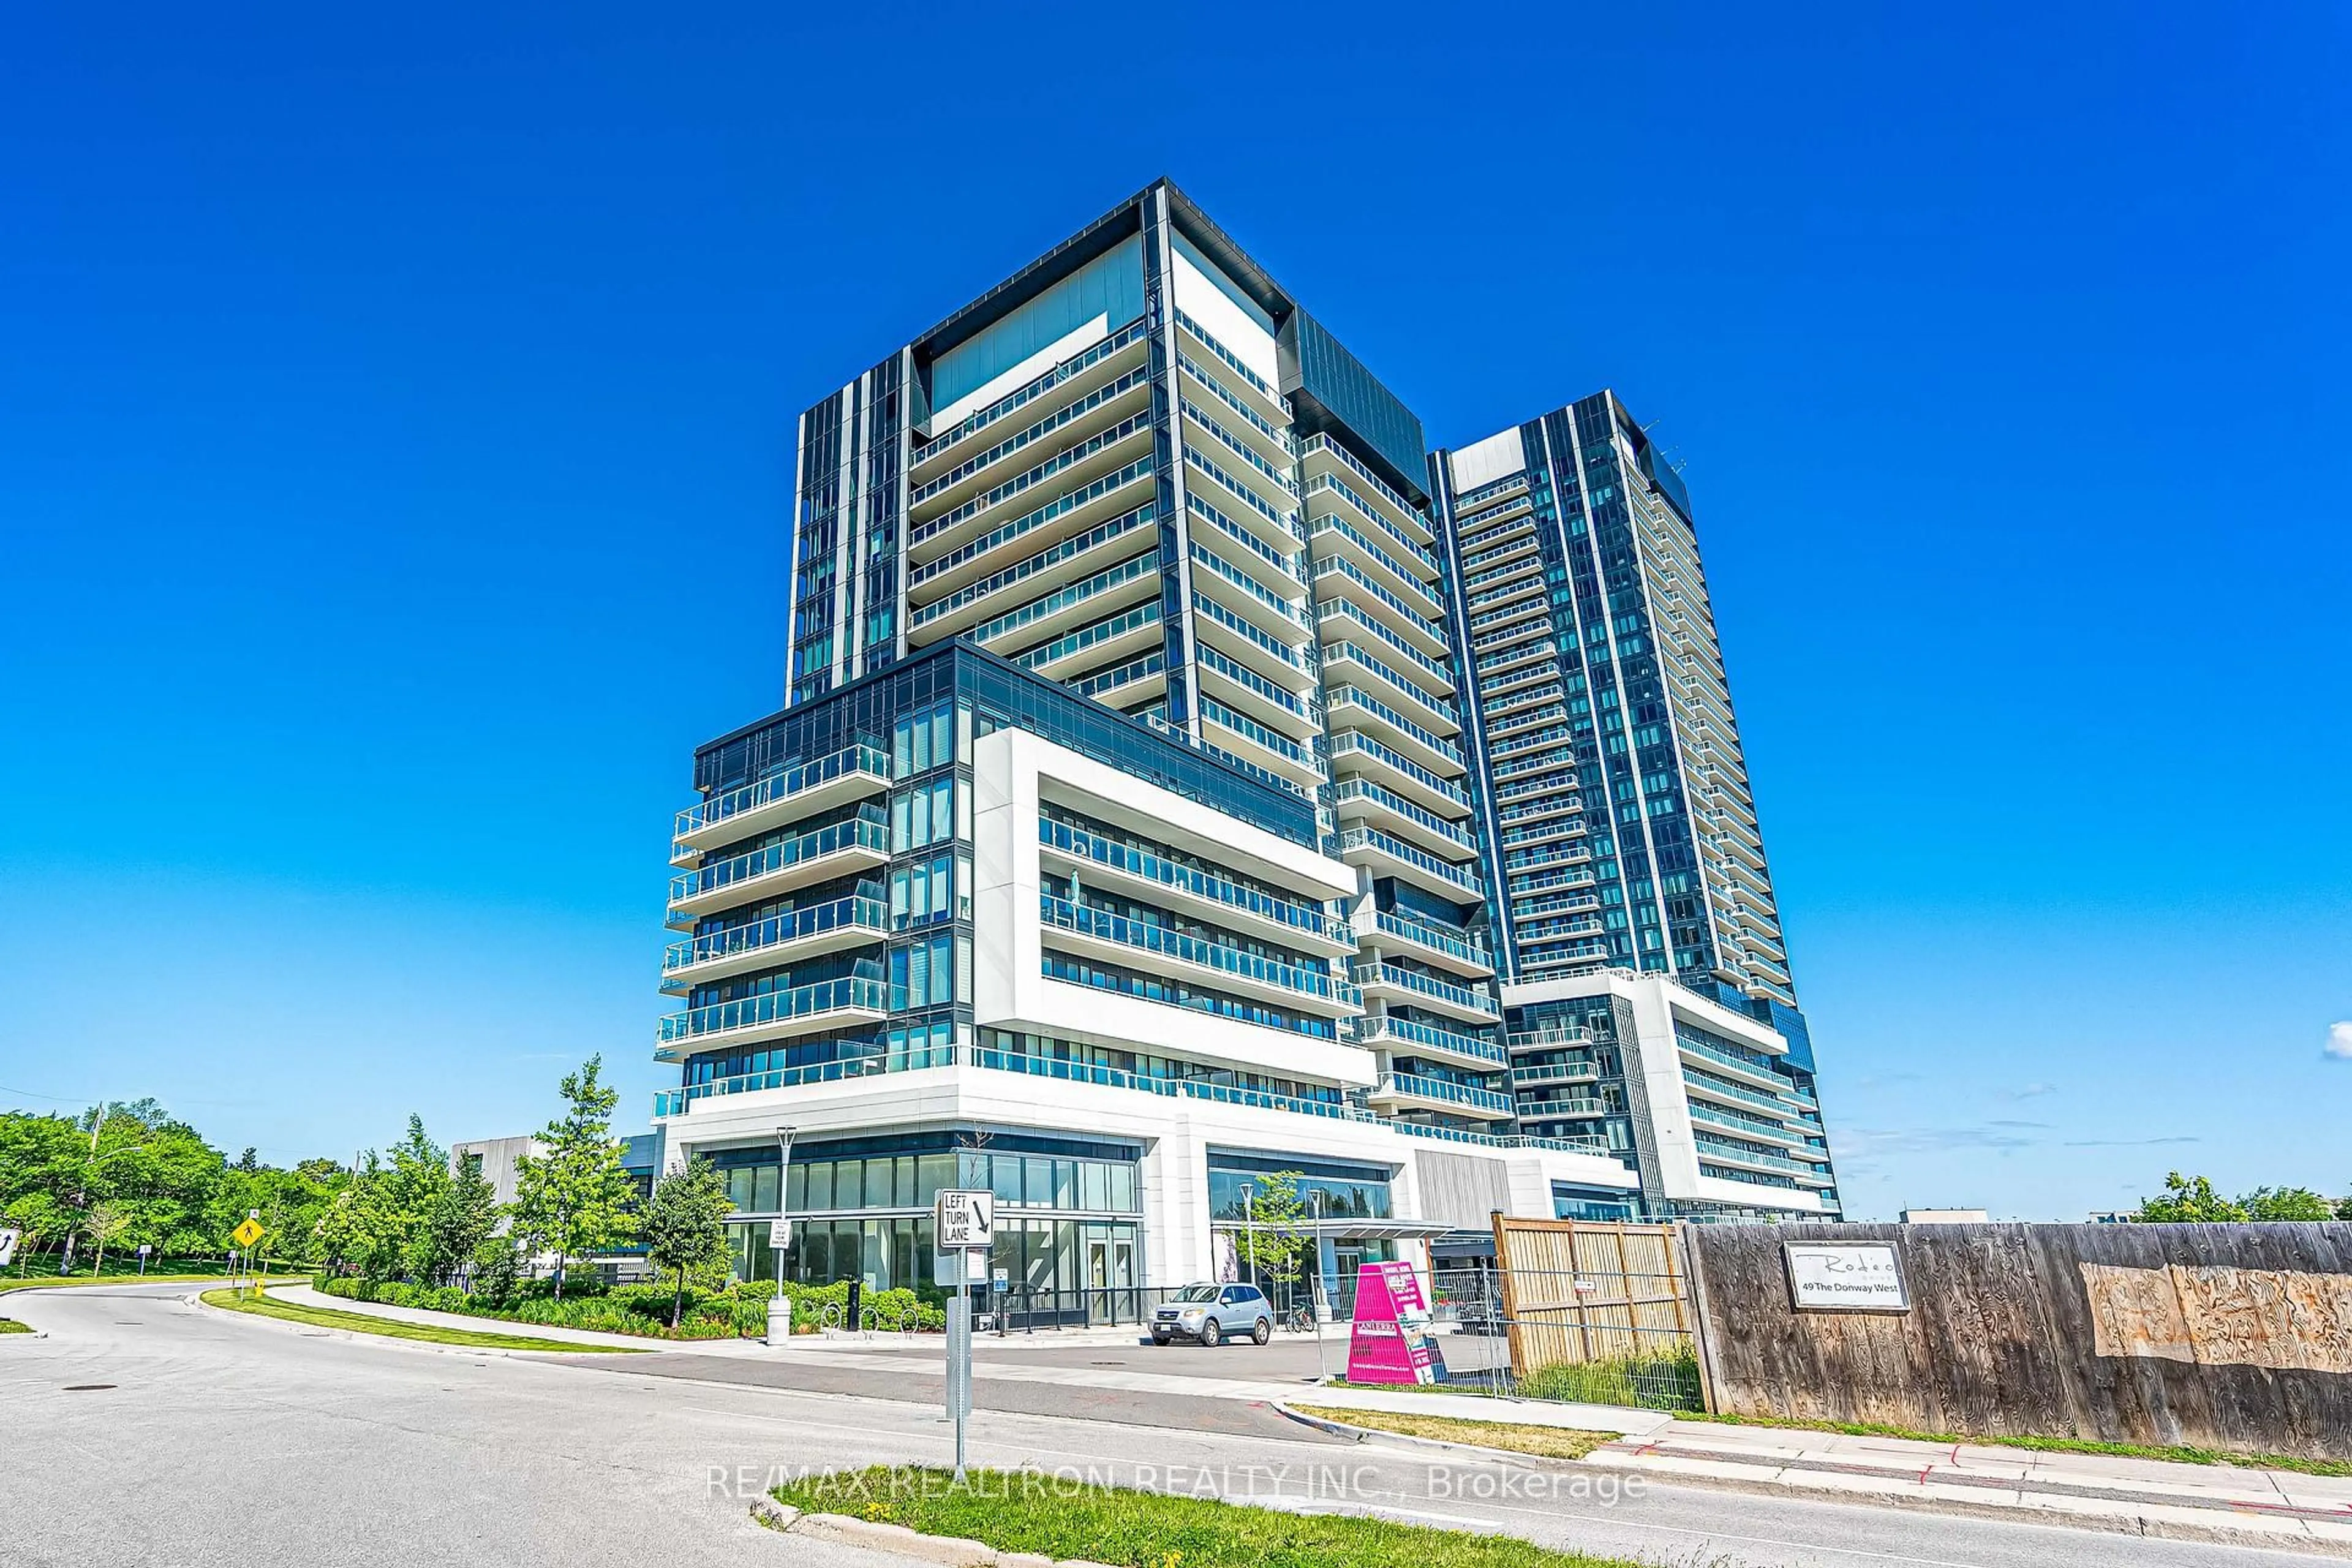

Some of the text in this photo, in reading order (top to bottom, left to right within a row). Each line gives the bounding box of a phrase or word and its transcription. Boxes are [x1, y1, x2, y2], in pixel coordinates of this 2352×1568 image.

[945, 1195, 967, 1208] LEFT
[945, 1212, 969, 1225] TURN
[945, 1227, 970, 1241] LANE
[1796, 1254, 1894, 1273] Rodeo
[1814, 1283, 1833, 1292] The
[1834, 1283, 1873, 1294] Donway
[1874, 1283, 1899, 1293] West
